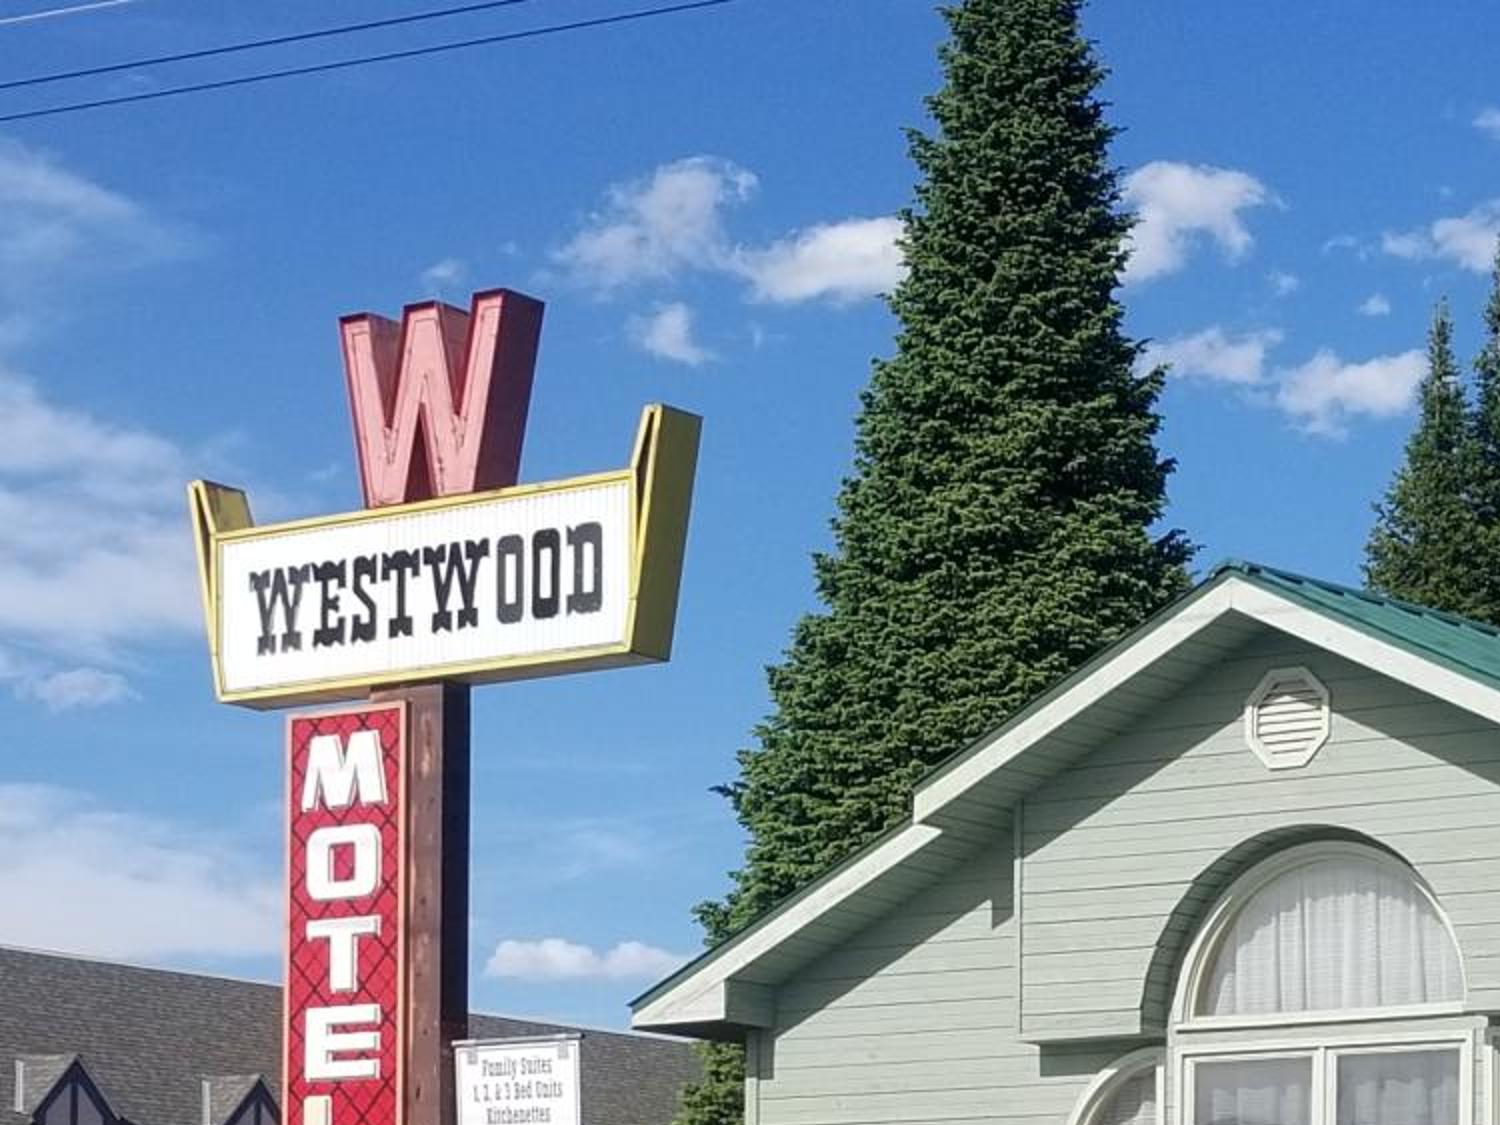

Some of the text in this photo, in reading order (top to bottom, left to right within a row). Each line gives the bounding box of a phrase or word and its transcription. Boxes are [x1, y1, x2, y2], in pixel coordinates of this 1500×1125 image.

[339, 288, 535, 508] W
[248, 521, 603, 656] WESTWOOD
[481, 1056, 553, 1080] Family Suites
[514, 1080, 532, 1100] Bed
[486, 1106, 551, 1125] Kitchenettes
